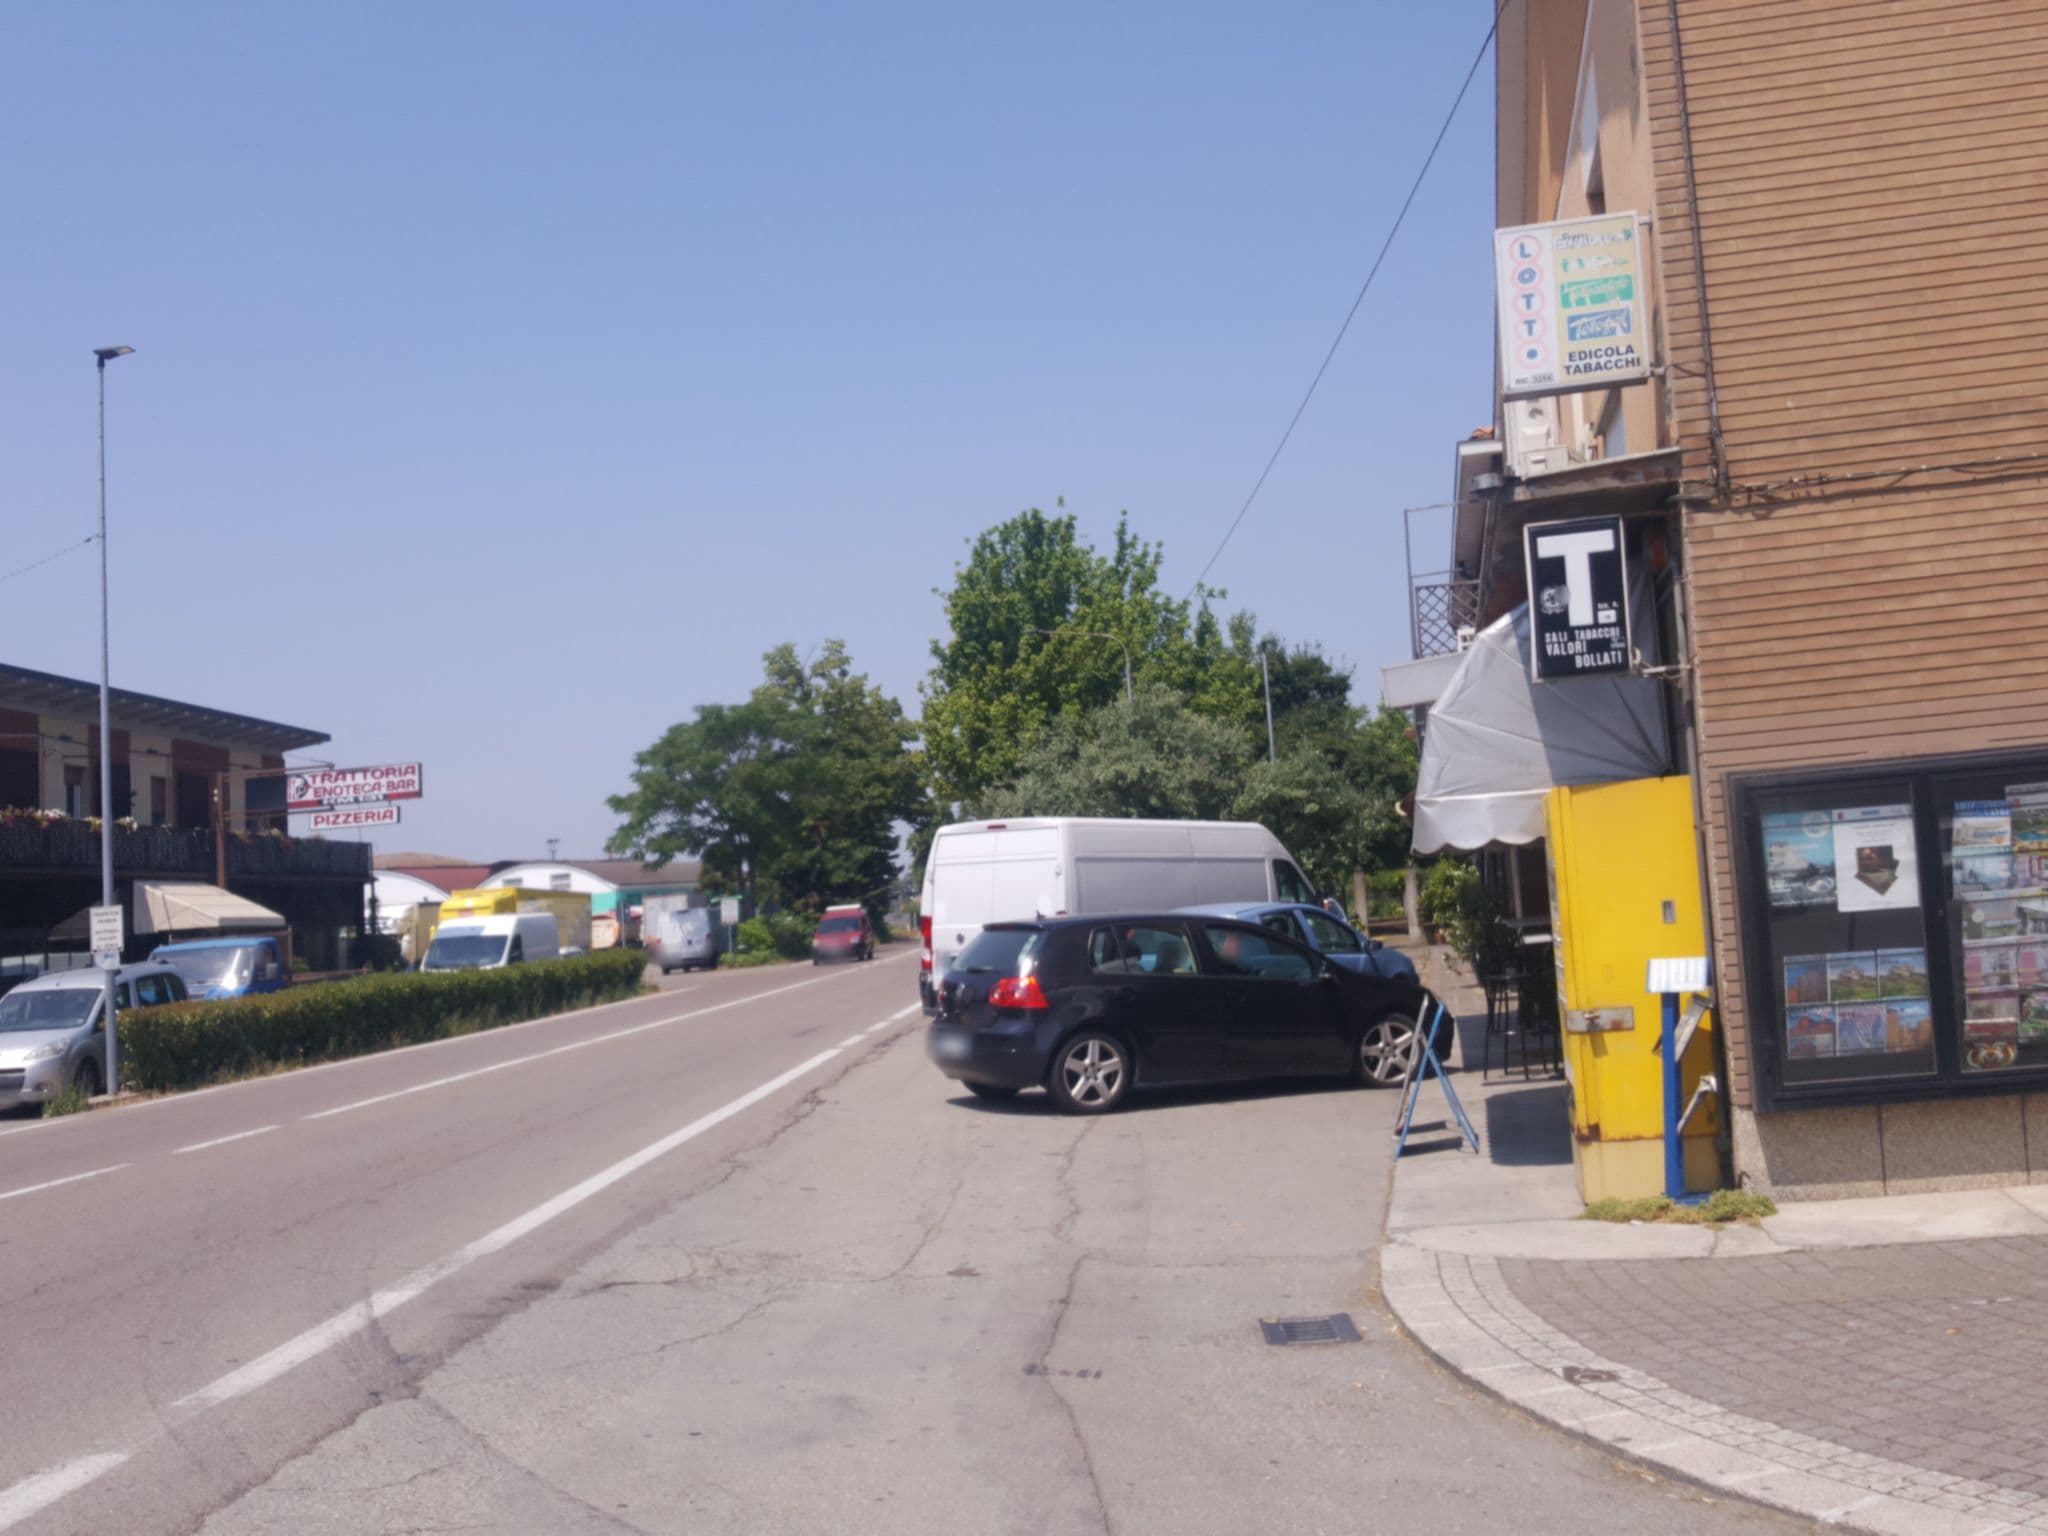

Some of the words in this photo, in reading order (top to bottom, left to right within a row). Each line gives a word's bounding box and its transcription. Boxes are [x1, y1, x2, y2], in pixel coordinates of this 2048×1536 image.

[1517, 242, 1539, 360] LOTTO
[1568, 344, 1635, 362] EDICOLA
[1564, 357, 1641, 375] TABACCHI
[1536, 529, 1615, 627] T
[1544, 631, 1568, 644] SALI
[1574, 626, 1620, 641] TABACCHI
[1546, 640, 1587, 657] VALORI
[1575, 652, 1622, 669] BOLLATI
[310, 765, 416, 784] TRATTORIA
[313, 810, 394, 827] PIZZERIA
